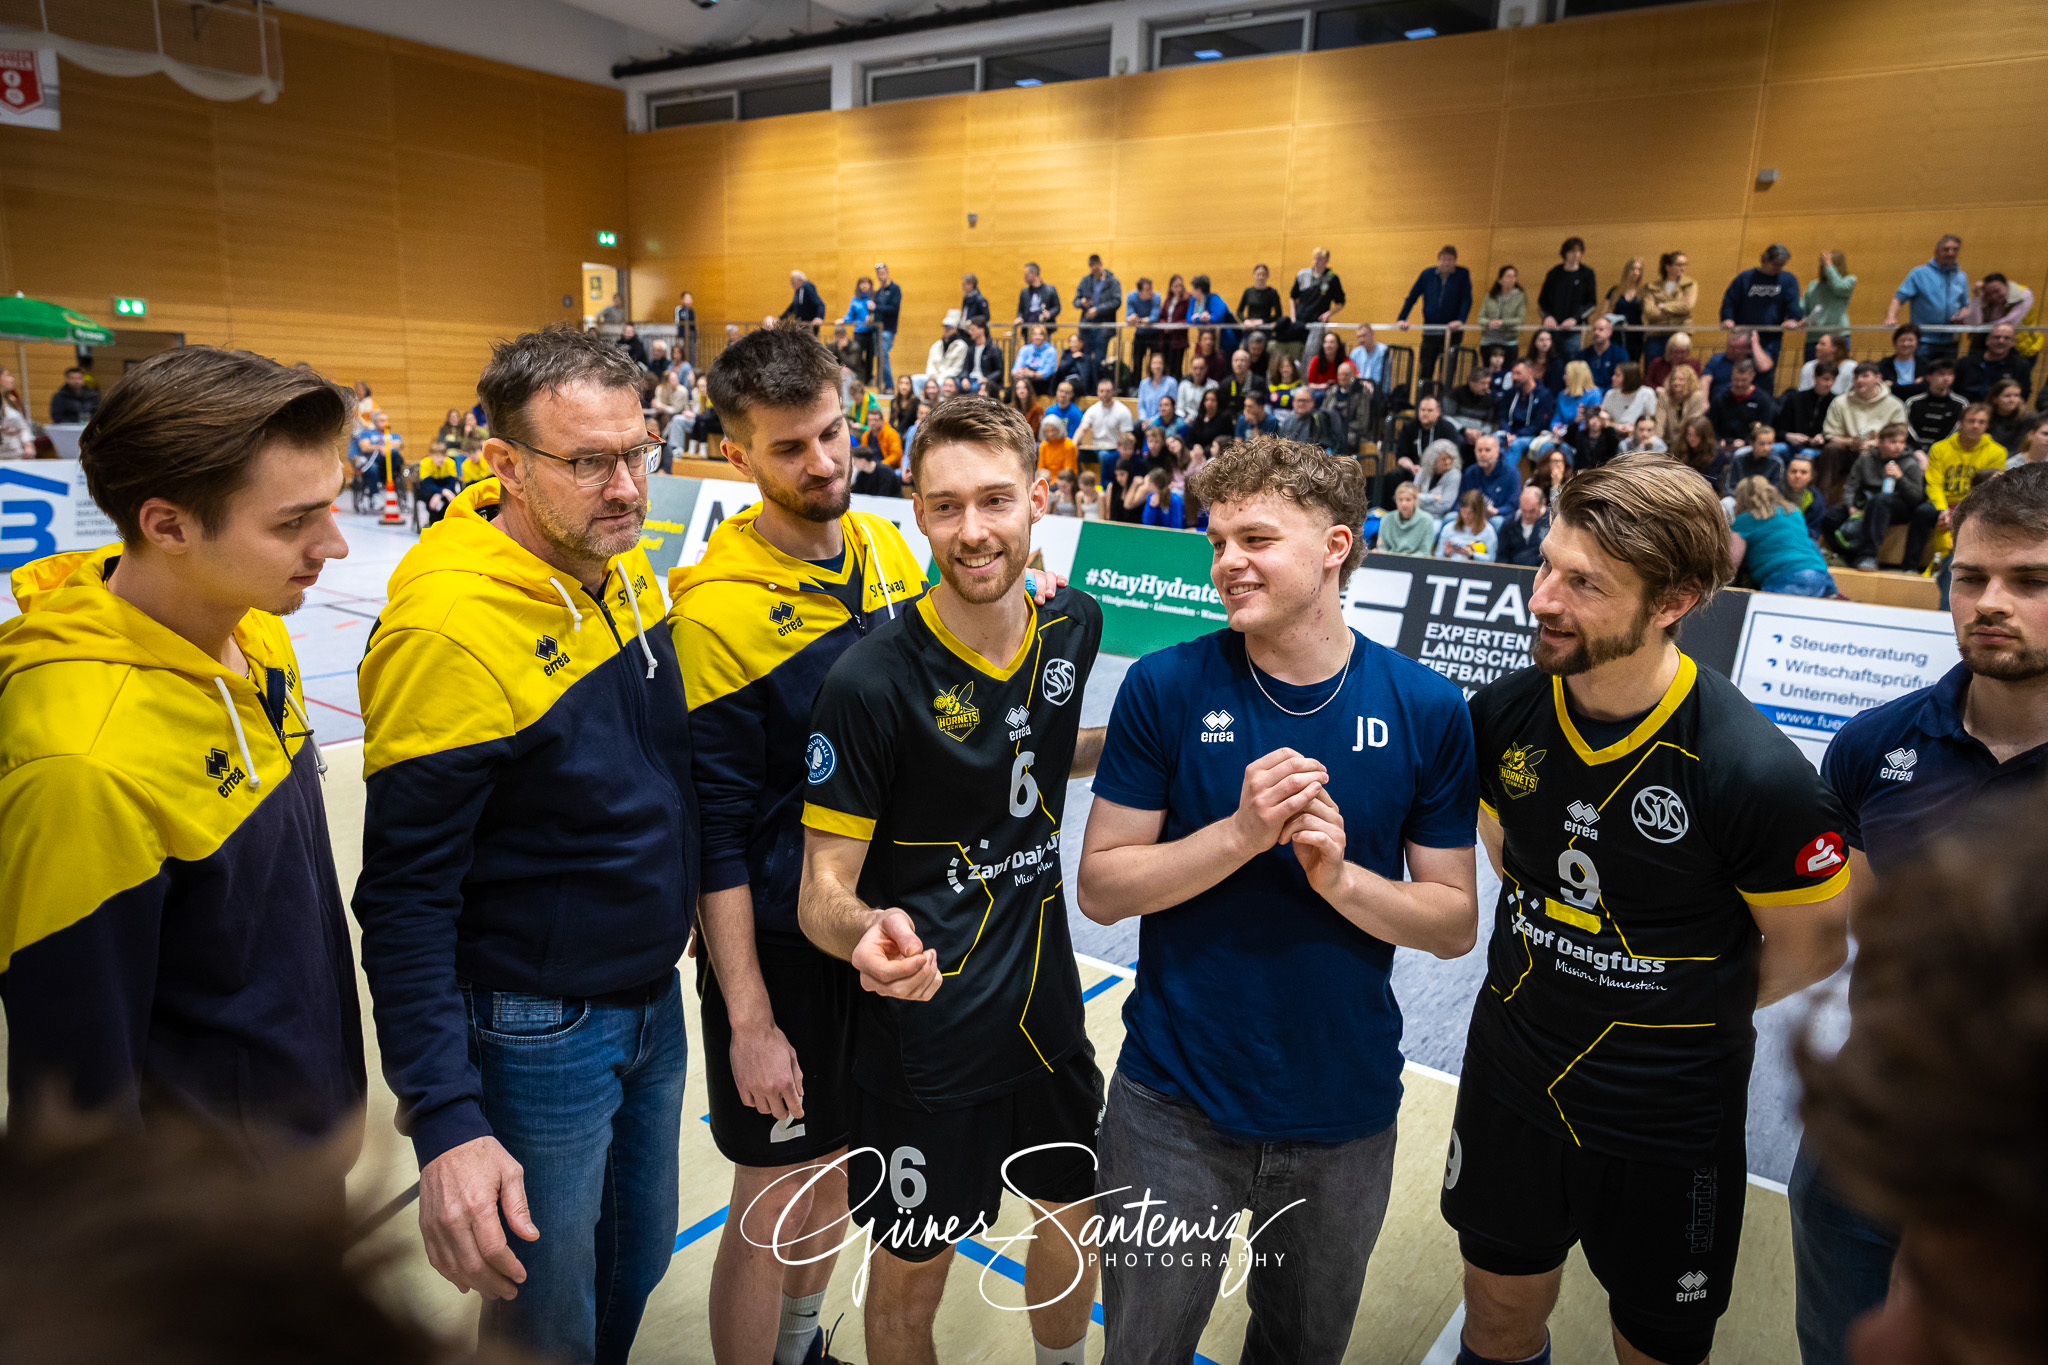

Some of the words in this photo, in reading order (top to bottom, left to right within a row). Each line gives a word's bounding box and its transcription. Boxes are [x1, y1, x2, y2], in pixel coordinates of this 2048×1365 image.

[1085, 568, 1224, 605] #StayHydrate
[777, 616, 804, 637] errea
[1425, 622, 1532, 652] EXPERTEN
[543, 652, 571, 676] errea
[1420, 640, 1535, 670] LANDSCHA
[1789, 635, 1928, 668] Steuerberatung
[1417, 657, 1502, 685] TIEFBAU
[1785, 659, 1936, 690] Wirtschaftsprüfu
[1779, 683, 1887, 708] Unternehme
[938, 711, 978, 728] HORNETS
[946, 722, 973, 731] SCHWAIG
[1775, 711, 1847, 731] www.fue
[1008, 725, 1032, 742] errea
[1200, 731, 1234, 743] errea
[1352, 716, 1388, 752] JD
[218, 767, 246, 798] errea
[1009, 751, 1038, 818] 6
[1501, 767, 1536, 789] HORNETS
[1505, 779, 1527, 791] SCHWAIG
[1880, 767, 1913, 782] errea
[1564, 820, 1599, 841] errea
[967, 855, 1012, 880] Zapf
[1558, 849, 1601, 910] 9
[1515, 912, 1556, 948] Zapf
[1557, 936, 1666, 973] Daigfuss
[1599, 973, 1668, 991] Mauerstein
[1444, 1128, 1462, 1189] 9
[889, 1145, 927, 1208] 6
[1676, 1287, 1707, 1303] errea
